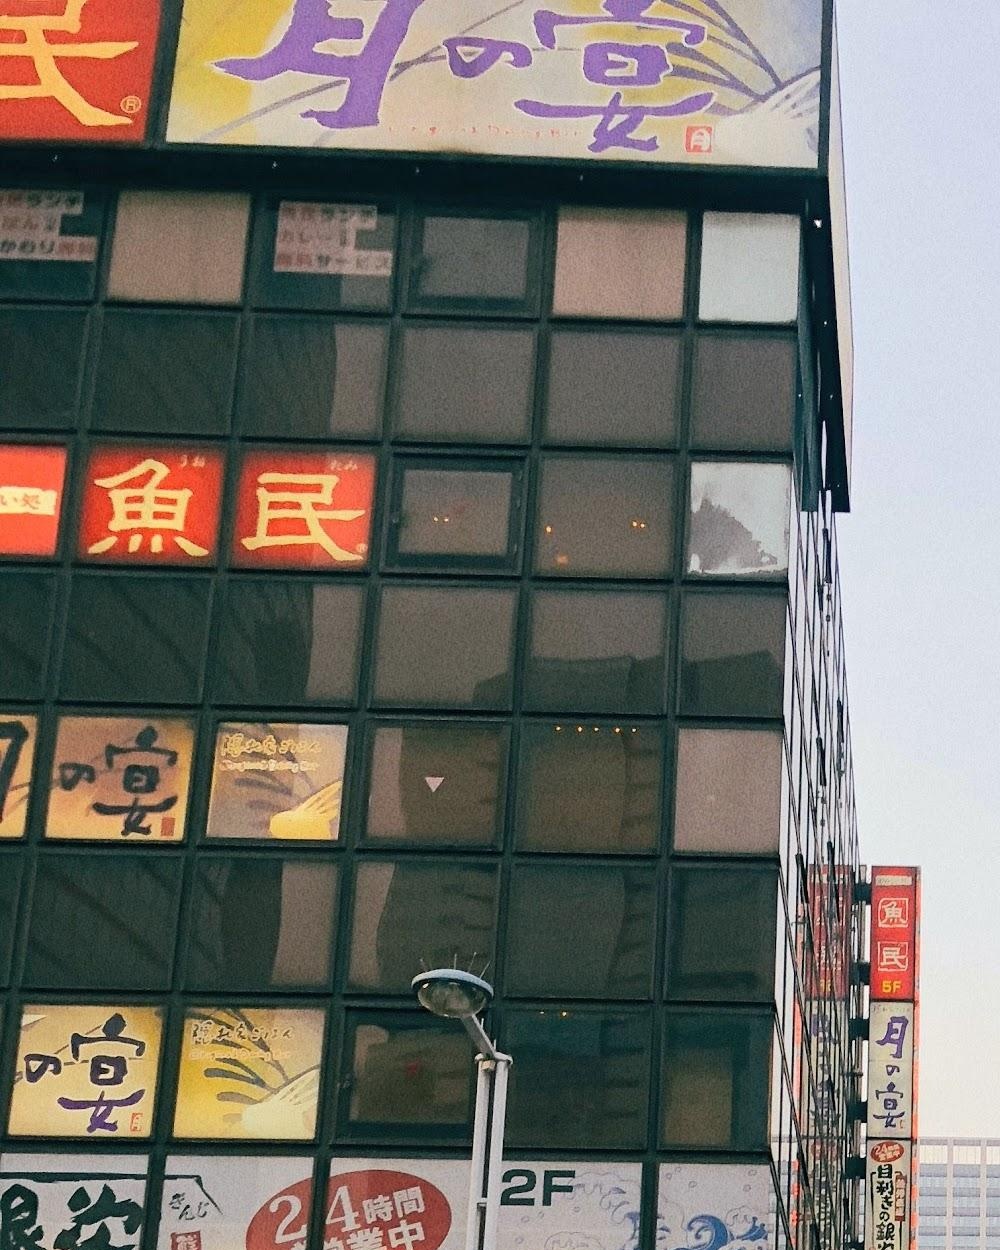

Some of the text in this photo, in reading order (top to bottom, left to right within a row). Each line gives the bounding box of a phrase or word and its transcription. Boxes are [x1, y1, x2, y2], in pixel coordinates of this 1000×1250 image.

[209, 0, 716, 153] 月の宴
[87, 458, 367, 561] 魚民
[879, 898, 908, 971] 魚民
[881, 980, 903, 993] 5F
[873, 1015, 910, 1128] 月の宴
[268, 1185, 426, 1246] 24時間
[500, 1169, 576, 1207] 2F
